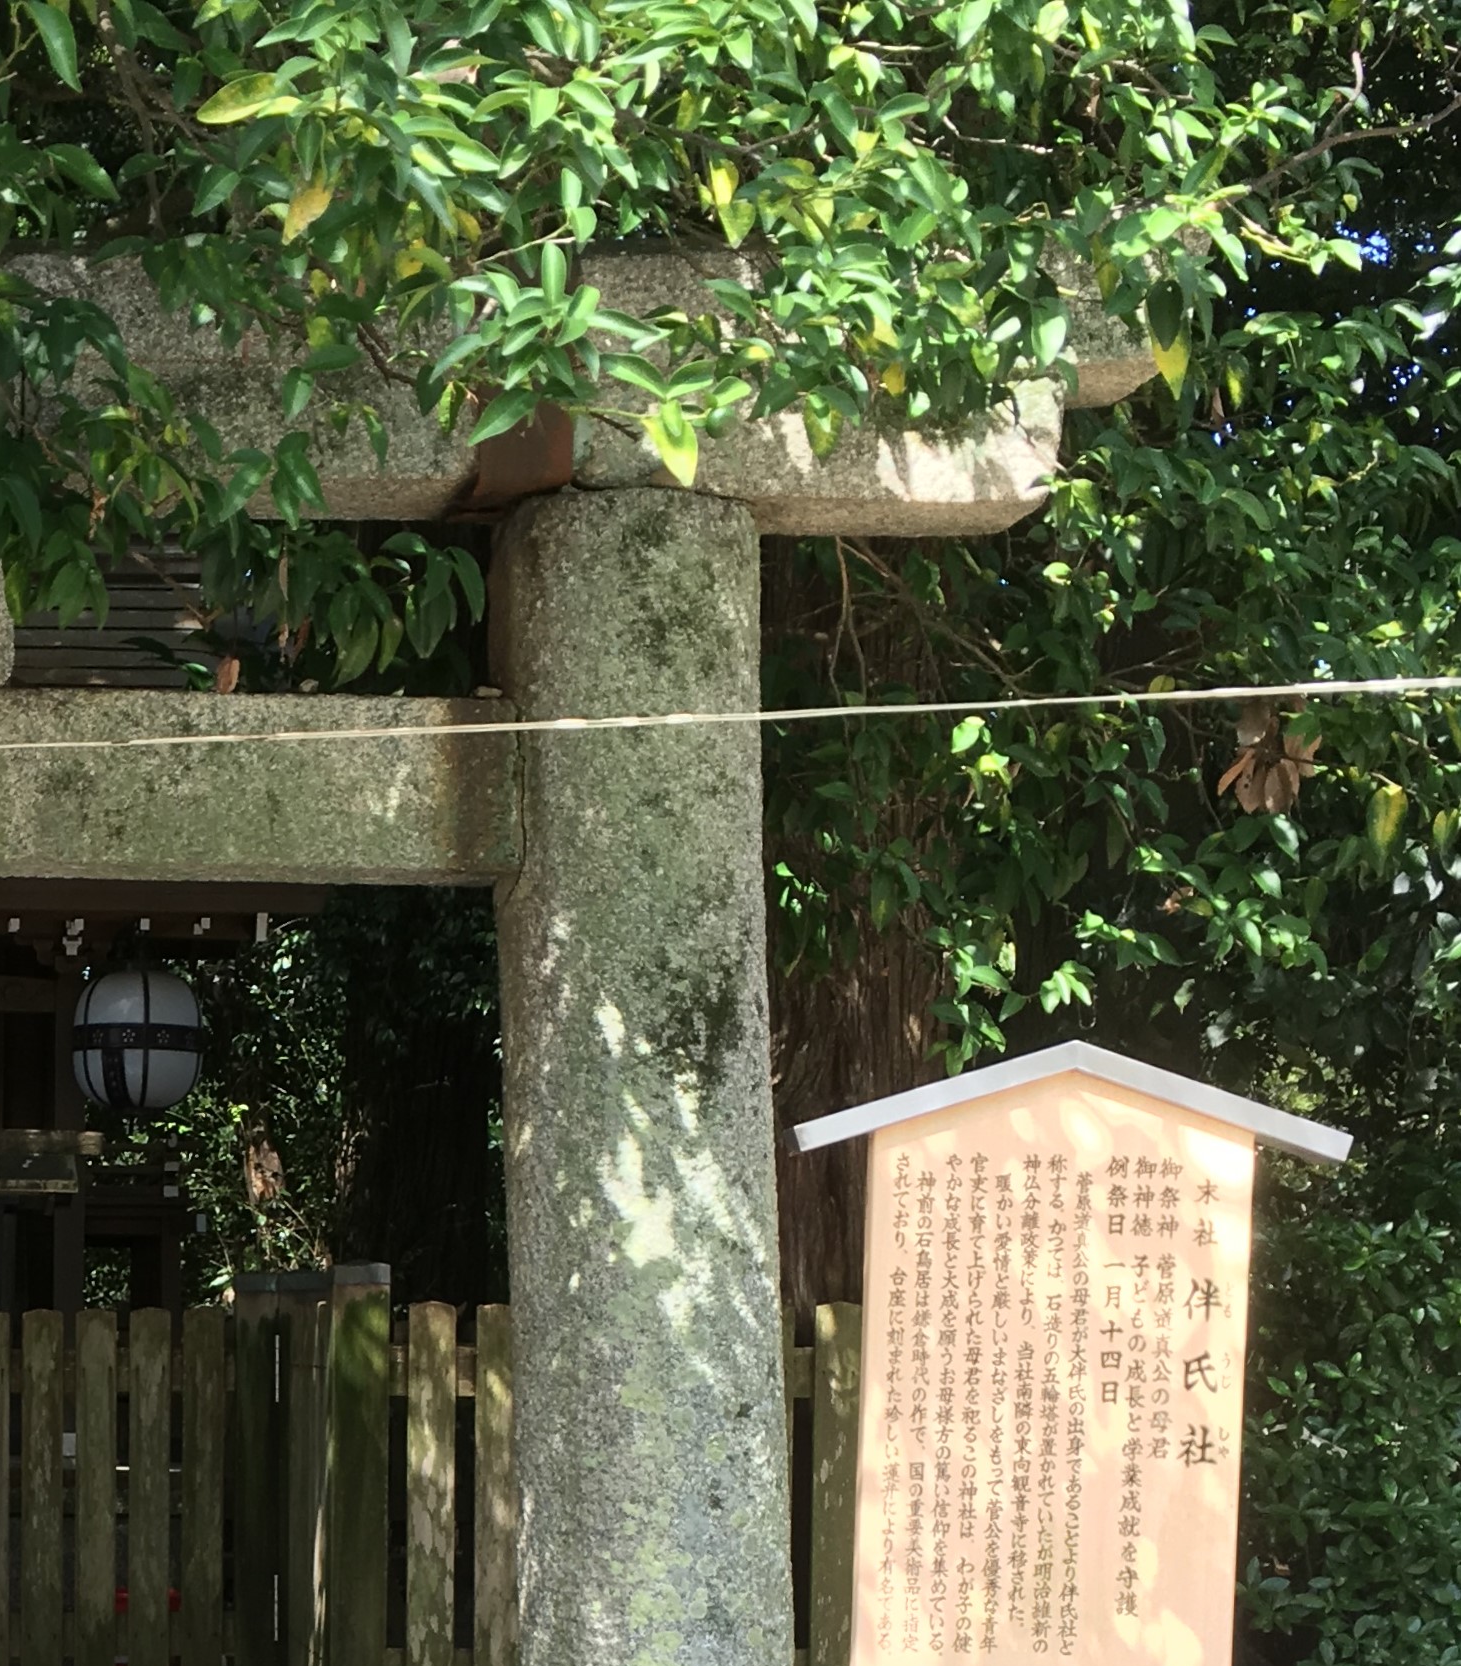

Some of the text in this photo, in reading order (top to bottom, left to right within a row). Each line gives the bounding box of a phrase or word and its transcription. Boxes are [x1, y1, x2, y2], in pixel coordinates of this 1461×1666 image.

[1099, 1154, 1130, 1405] 例祭日 一月十四日
[1114, 1155, 1157, 1618] 御神徳 子どもの成長と学業成就を守護
[1147, 1156, 1184, 1460] 御祭神 菅原道真公の母君
[1176, 1178, 1223, 1468] 末社 伴氏社
